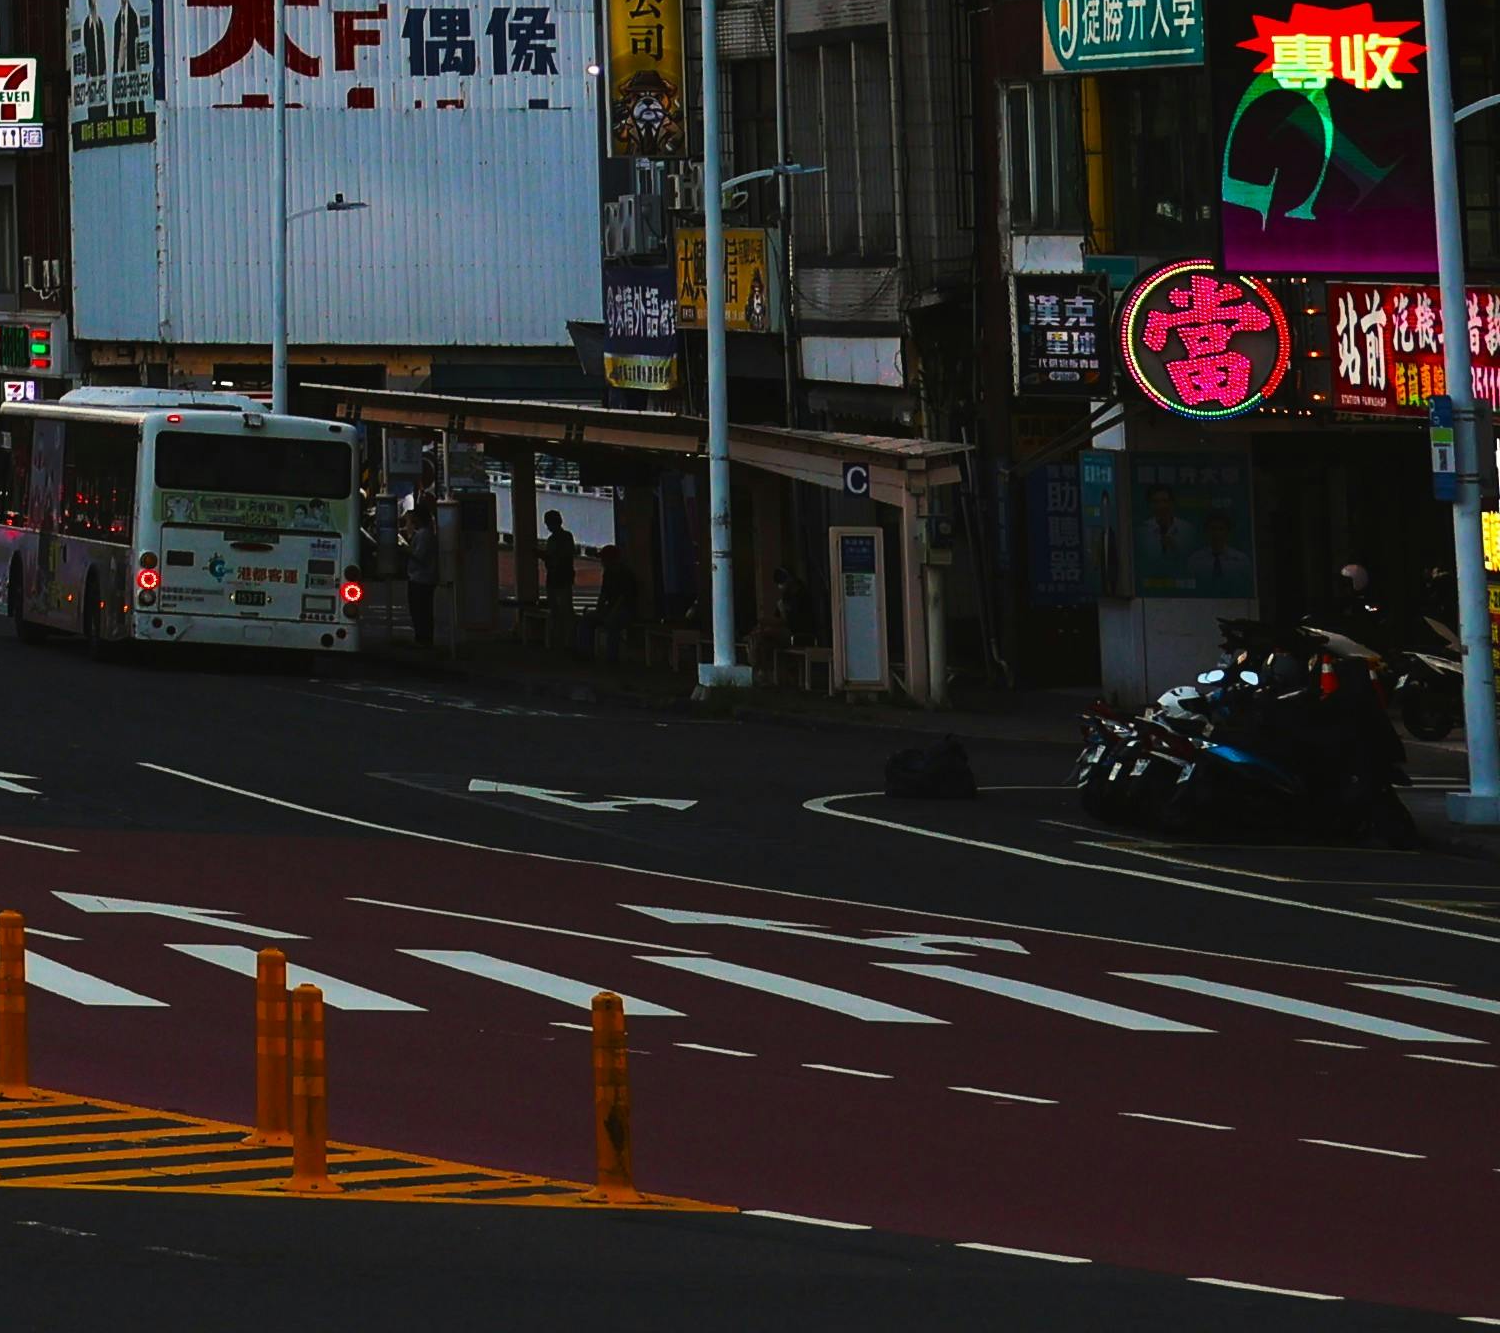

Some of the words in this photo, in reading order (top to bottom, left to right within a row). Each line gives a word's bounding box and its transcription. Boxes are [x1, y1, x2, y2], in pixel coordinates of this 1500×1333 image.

[401, 5, 557, 77] 偶像
[1269, 34, 1403, 89] 專收
[1028, 293, 1096, 328] 漢克
[1141, 273, 1271, 409] 當
[1336, 289, 1387, 391] 站前
[846, 465, 868, 495] C
[1047, 484, 1082, 583] 助聽器
[237, 565, 298, 584] 港都客運
